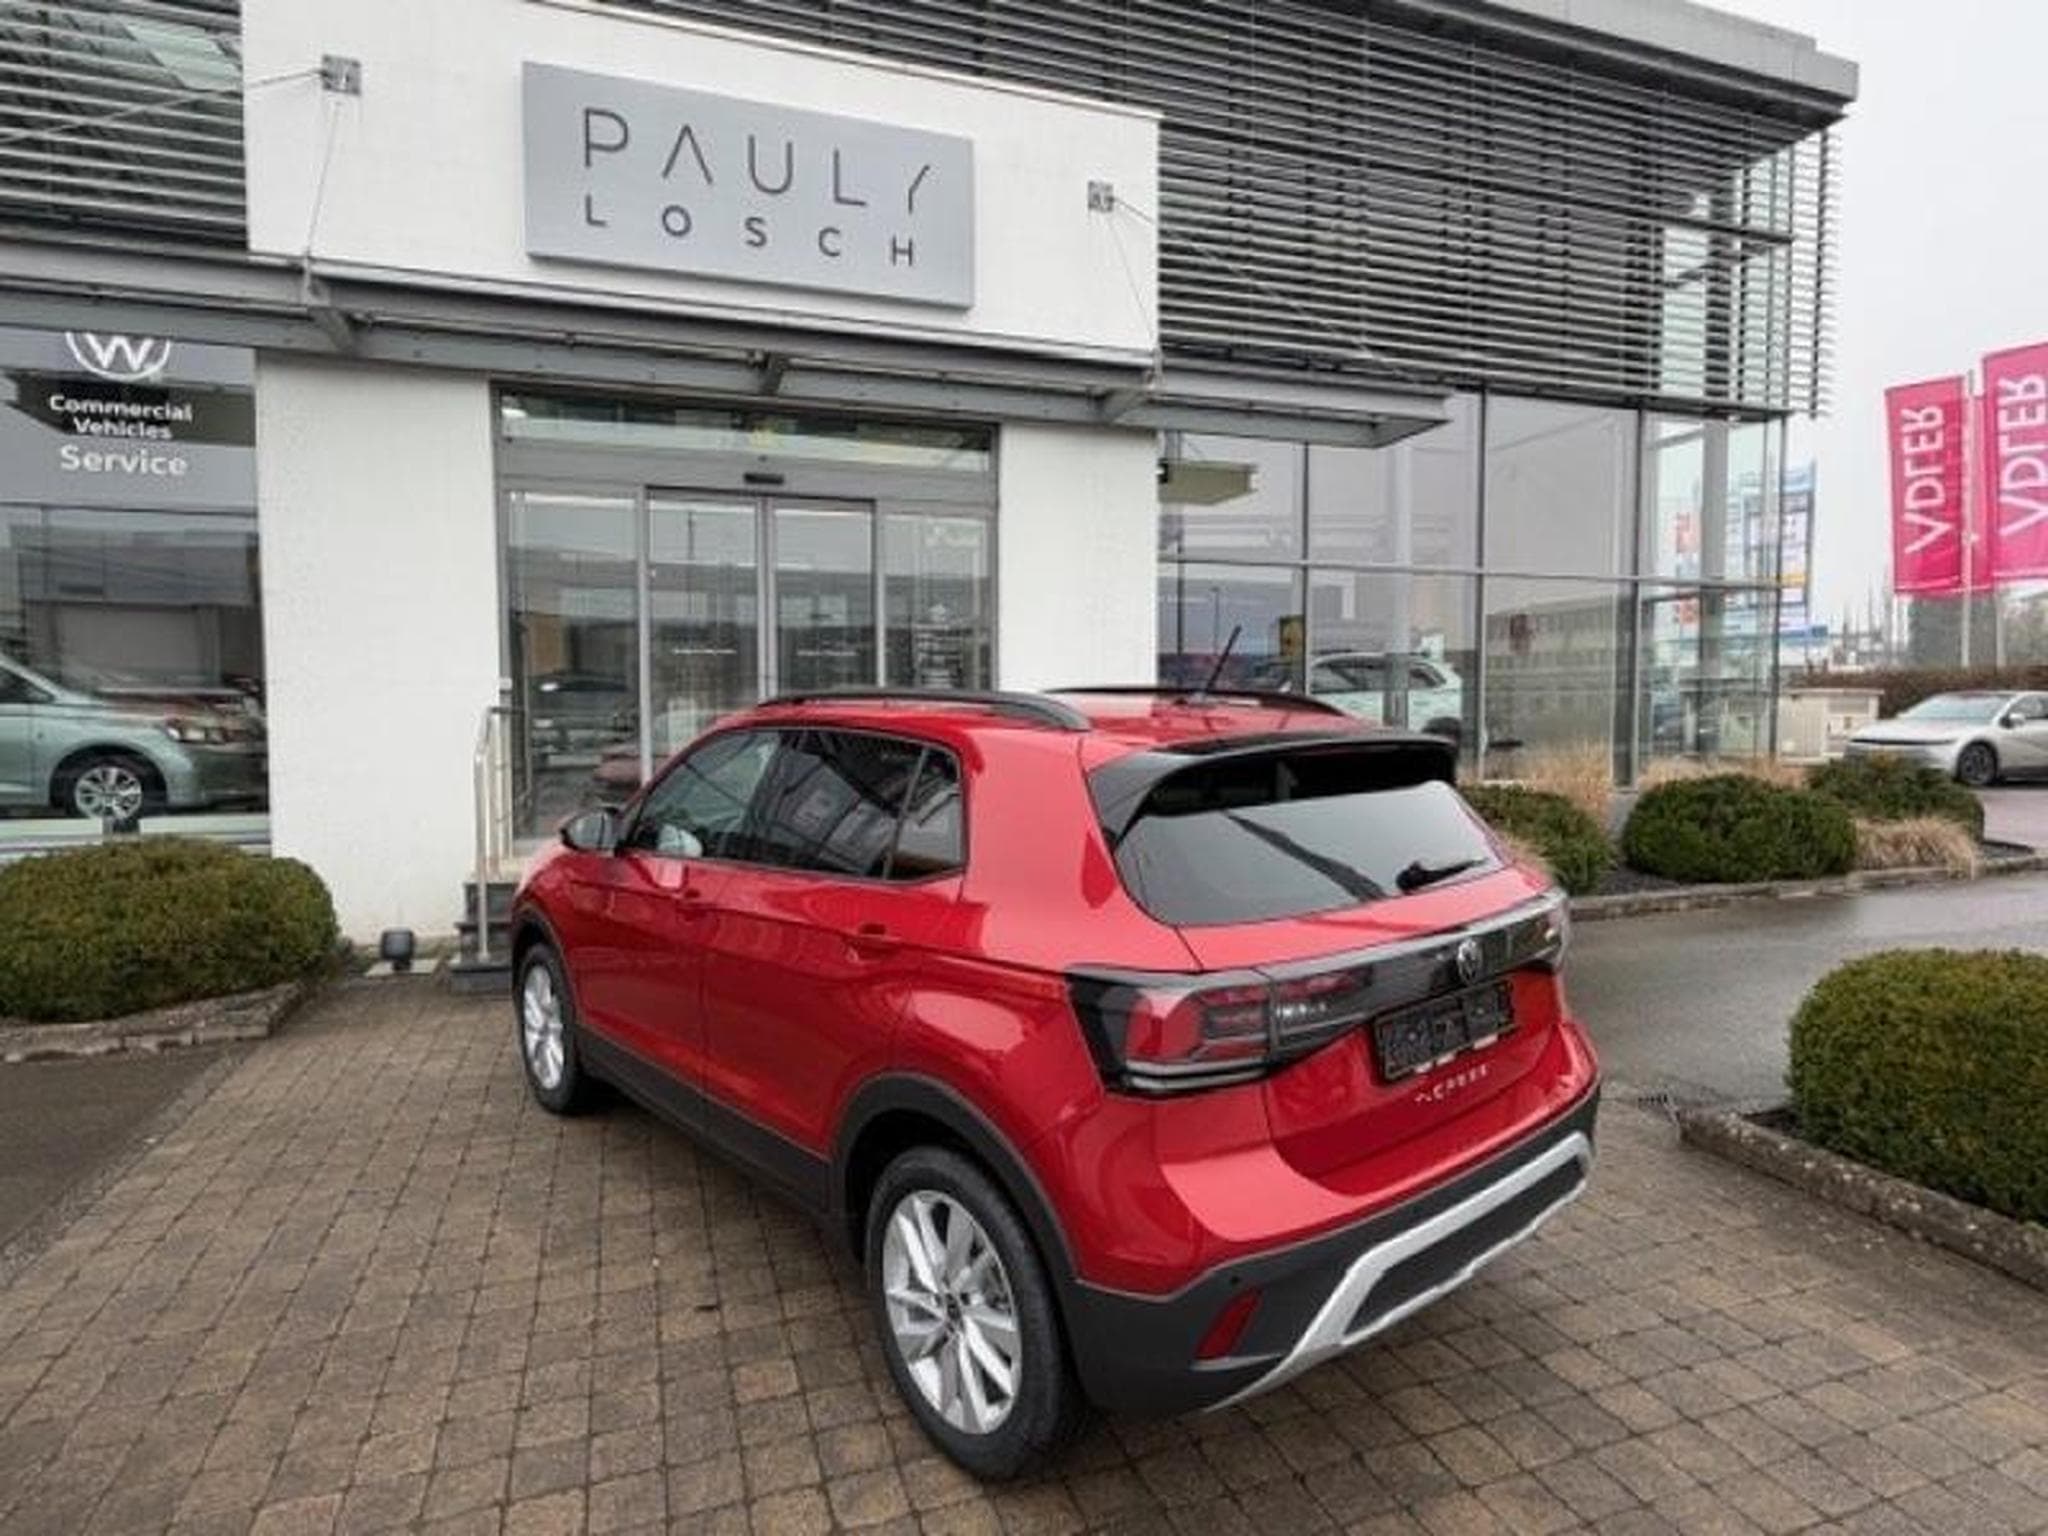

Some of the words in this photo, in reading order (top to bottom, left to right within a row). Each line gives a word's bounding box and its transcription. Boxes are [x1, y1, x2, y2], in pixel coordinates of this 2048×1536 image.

[584, 106, 932, 213] PAULY
[584, 193, 914, 267] LOSCH
[49, 394, 194, 423] Commercial
[73, 416, 174, 440] Vehicles
[60, 444, 189, 476] Service
